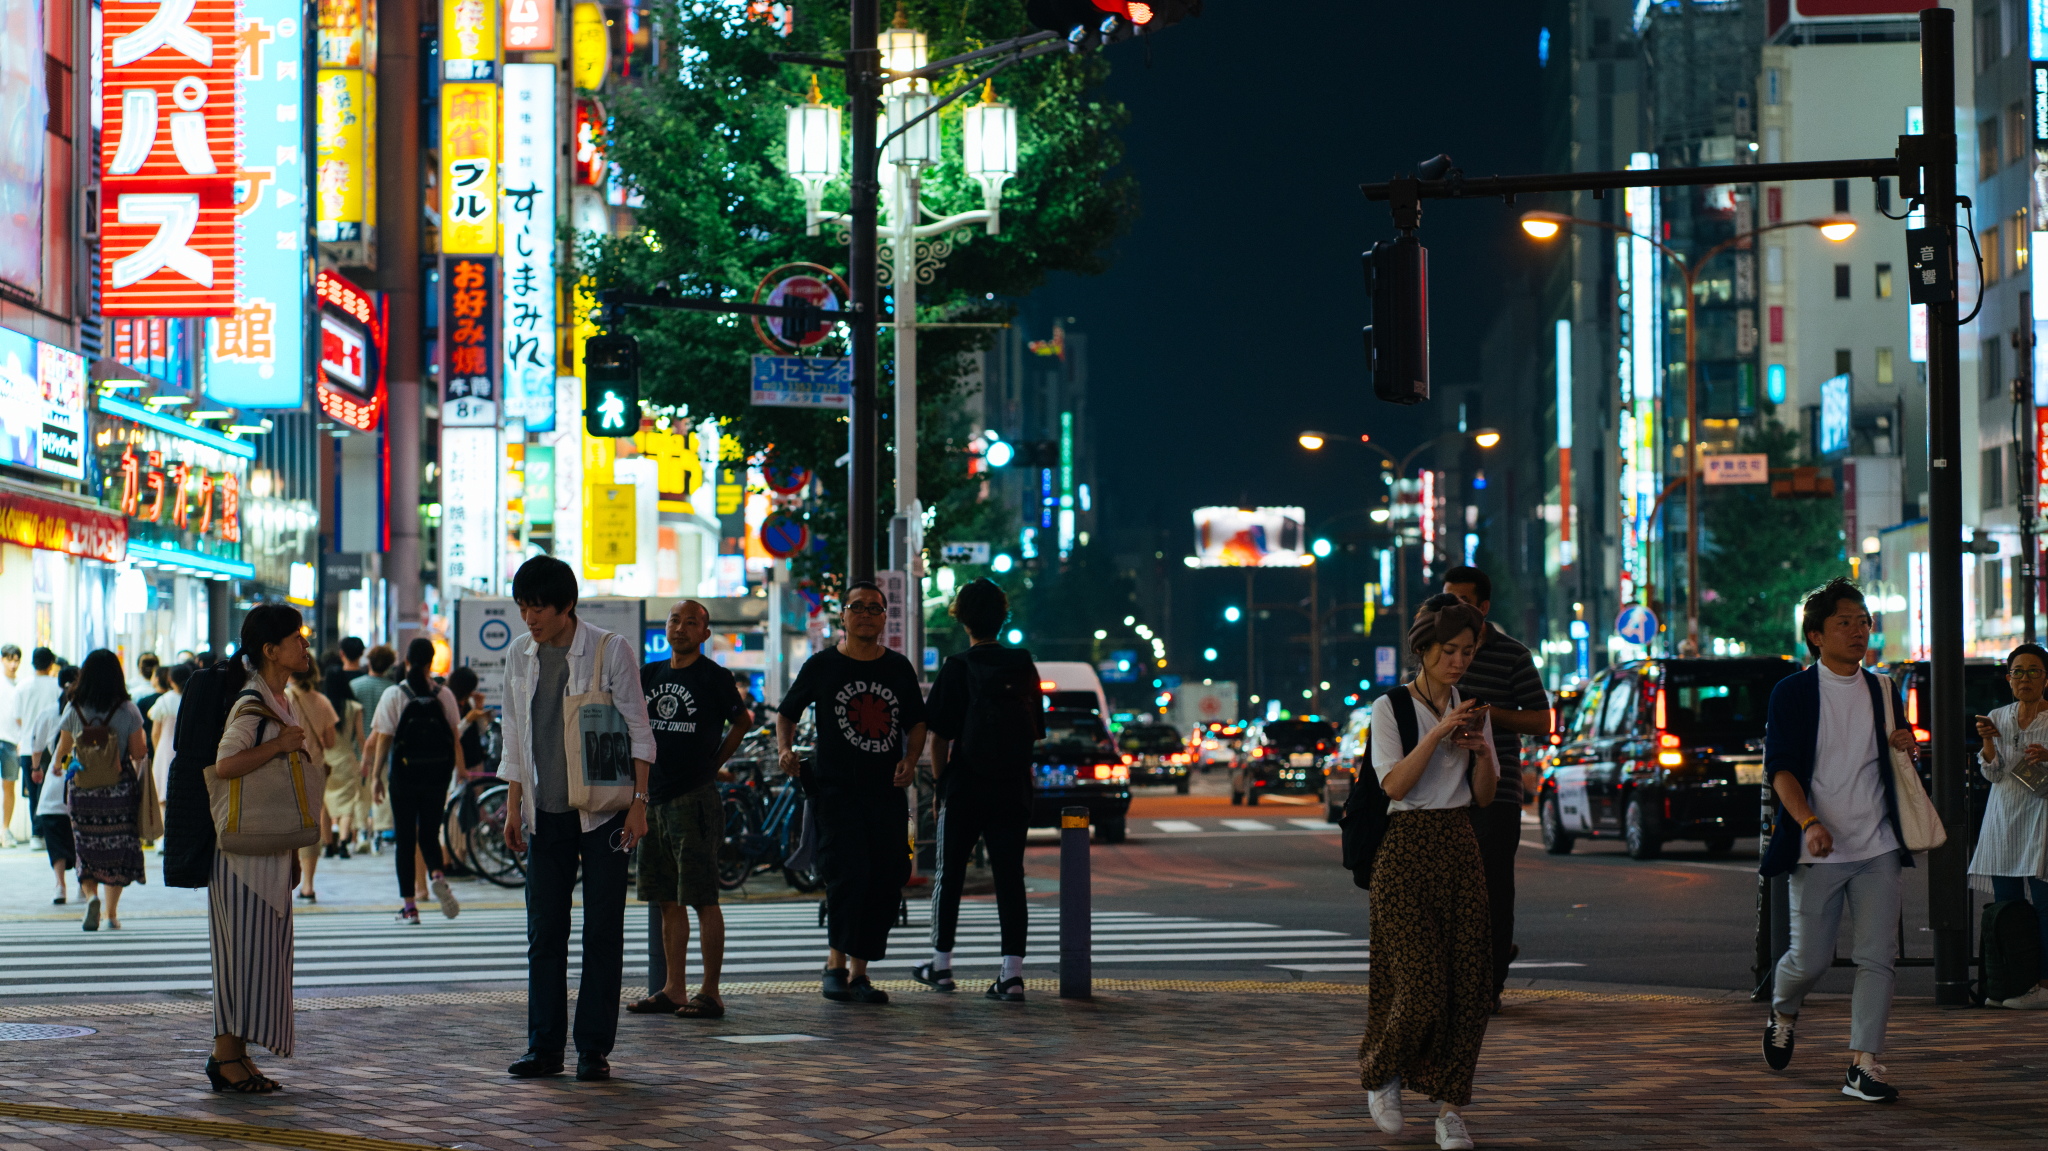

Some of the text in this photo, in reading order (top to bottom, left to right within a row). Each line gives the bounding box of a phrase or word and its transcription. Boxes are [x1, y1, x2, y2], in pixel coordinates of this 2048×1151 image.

[504, 181, 546, 371] すしまみれ
[1919, 245, 1937, 285] 音響
[452, 260, 488, 375] お好み焼
[121, 442, 239, 542] カラオケ館
[645, 683, 698, 717] ALIFORNIA
[649, 719, 697, 733] IFIC UNION
[834, 681, 900, 753] RED HOT CHILI PEPPERS
